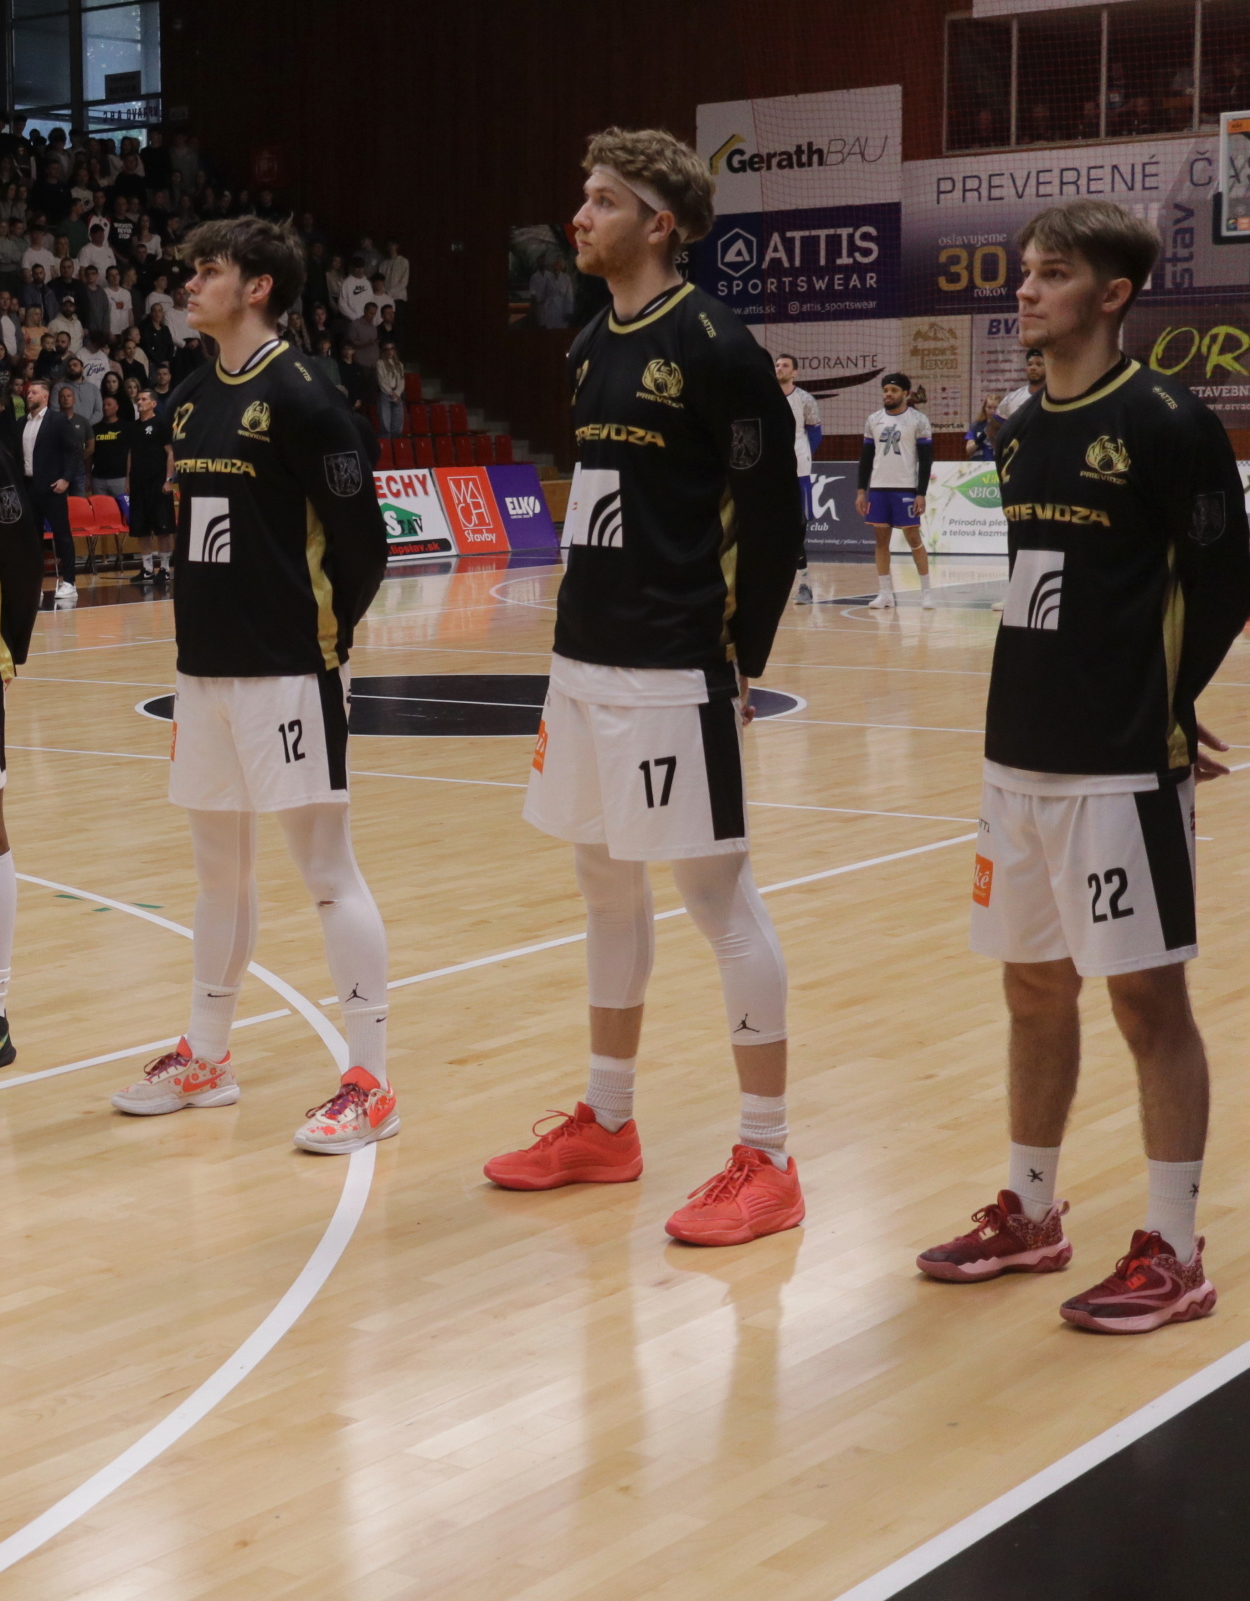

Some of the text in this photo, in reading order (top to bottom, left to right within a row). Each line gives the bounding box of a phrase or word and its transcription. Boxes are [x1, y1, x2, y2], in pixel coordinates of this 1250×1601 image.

[726, 134, 888, 174] GerathBAU
[936, 154, 1160, 205] PREVERENÉ
[761, 226, 879, 269] ATTIS
[938, 232, 1008, 247] oslavujeme
[1163, 202, 1195, 289] stav
[937, 245, 1008, 292] 30
[717, 273, 878, 296] SPORTSWEAR
[973, 285, 1008, 298] rokov
[801, 300, 878, 313] attis_sportswear
[987, 318, 1019, 335] BV
[1079, 470, 1129, 486] PRIEVIDZA
[810, 521, 829, 532] club
[948, 517, 987, 527] Prírodná
[464, 528, 497, 544] Stavby
[949, 528, 977, 537] telová
[277, 718, 307, 764] 12
[637, 755, 678, 810] 17
[1086, 866, 1135, 925] 22
